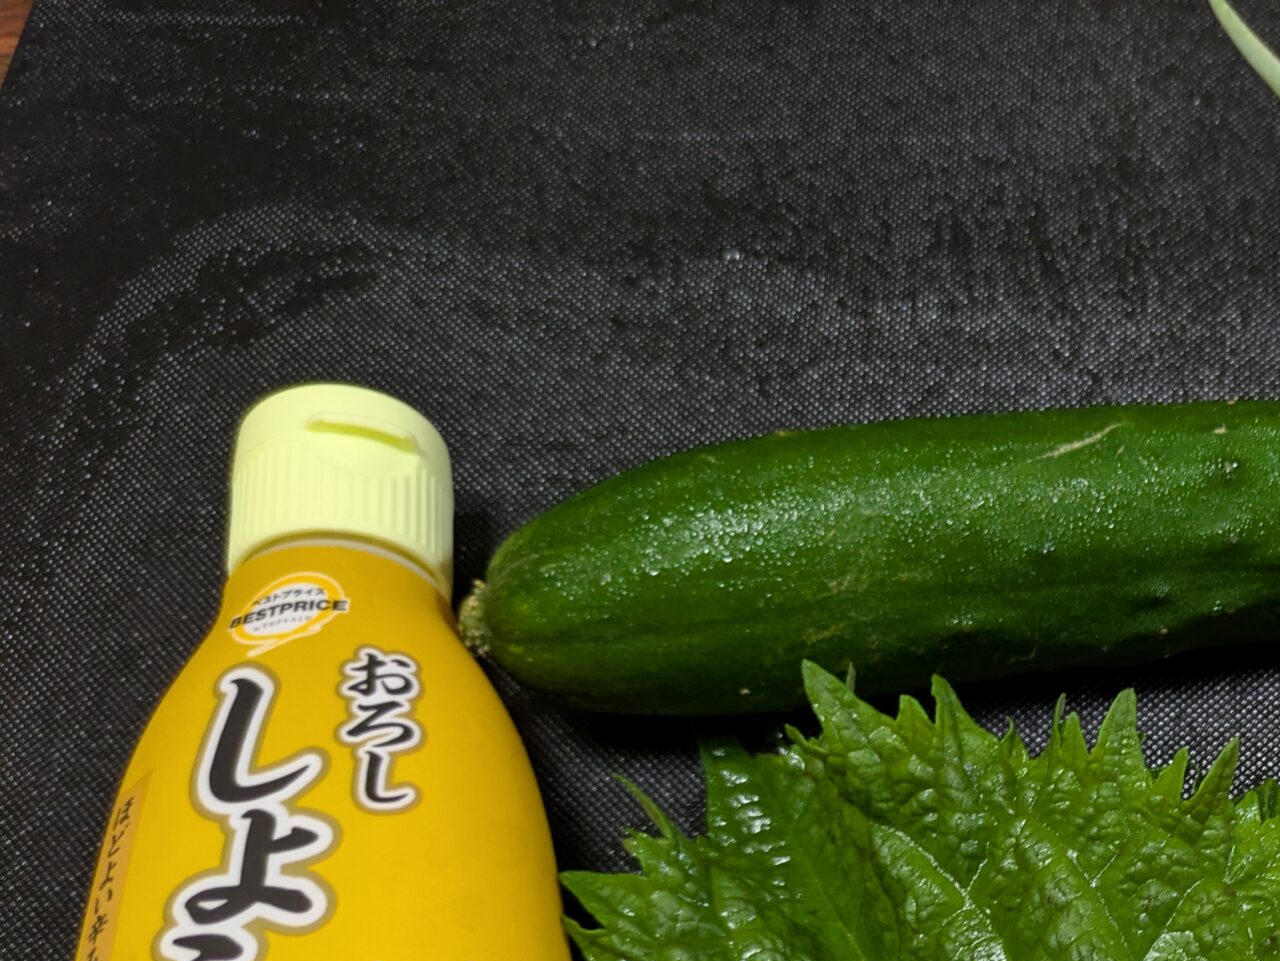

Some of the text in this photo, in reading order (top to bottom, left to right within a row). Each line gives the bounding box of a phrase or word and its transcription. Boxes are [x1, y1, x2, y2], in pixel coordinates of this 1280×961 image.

[229, 599, 350, 630] BESTPRICE
[345, 651, 416, 804] おろし
